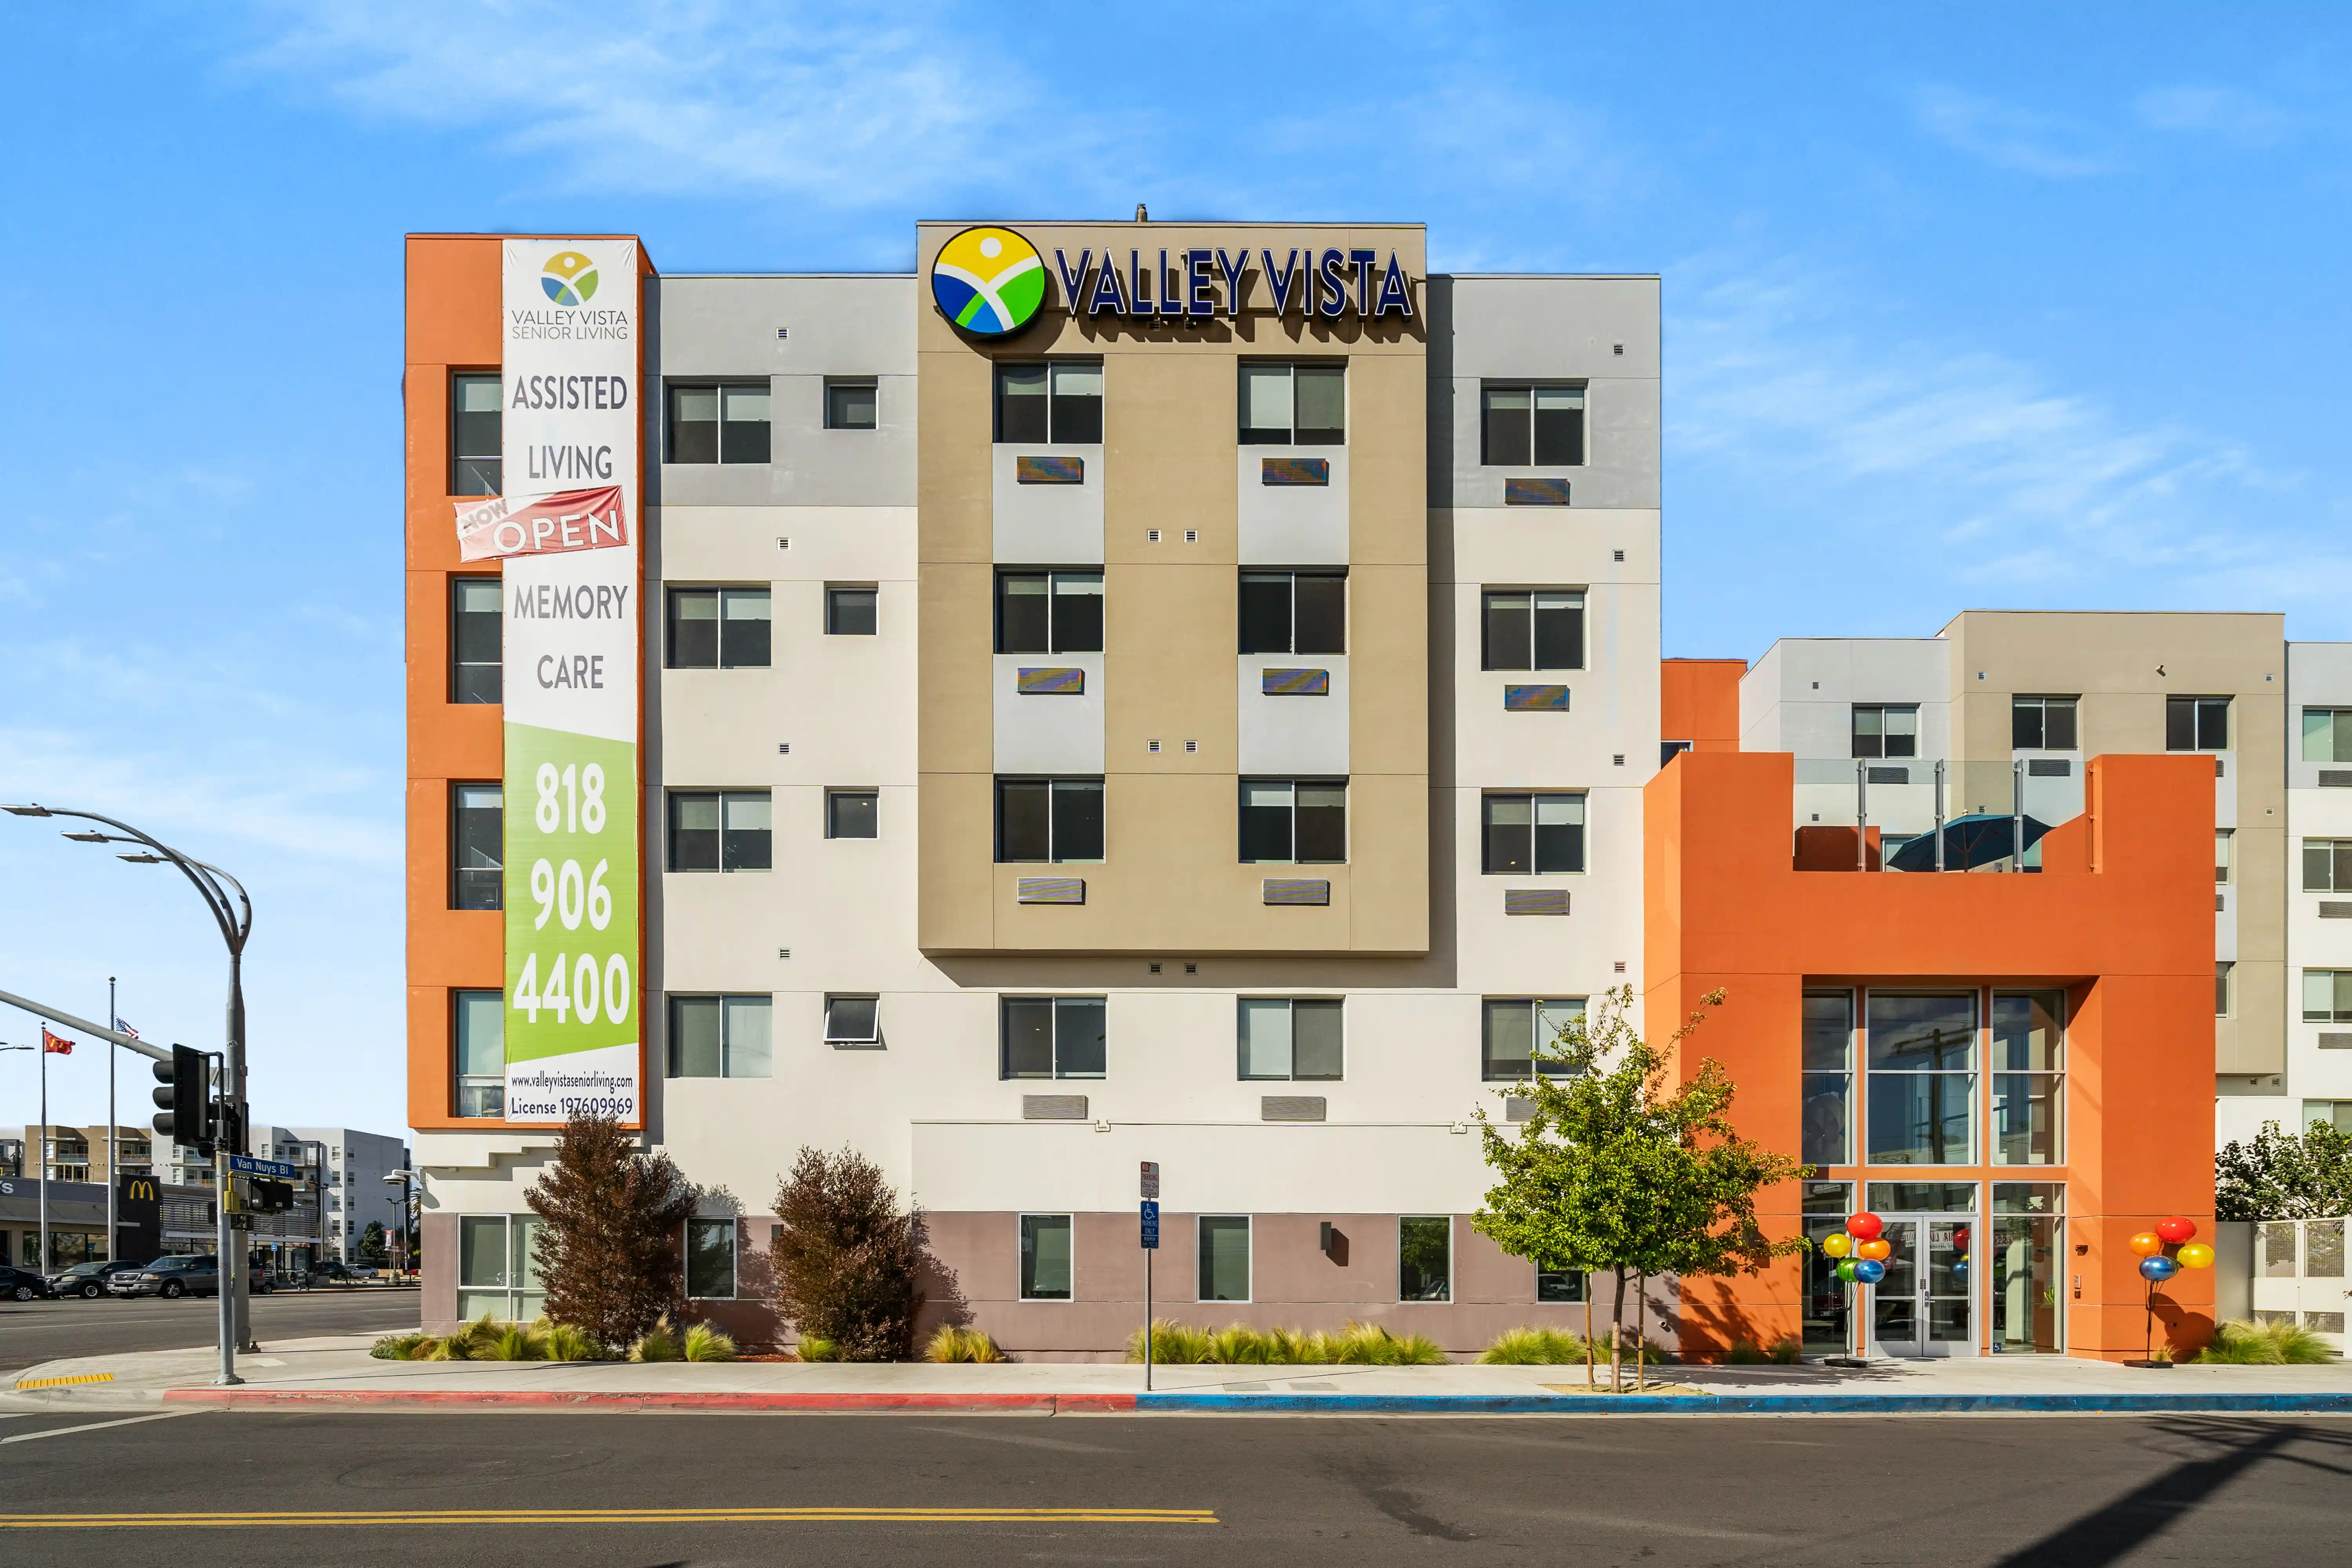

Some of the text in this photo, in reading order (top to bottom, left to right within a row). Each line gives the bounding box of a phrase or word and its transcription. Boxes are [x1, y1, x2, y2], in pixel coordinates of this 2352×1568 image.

[1054, 247, 1413, 316] VALLEY VISTA
[512, 310, 628, 325] VALLEY VISTA
[512, 327, 628, 340] SENIOR LIVING
[512, 375, 627, 410] ASSISTED
[529, 445, 612, 479] LIVING
[461, 498, 508, 534] NOW
[493, 509, 620, 554] OPEN
[514, 584, 628, 619] MEMORY
[537, 654, 604, 689] CARE
[535, 762, 606, 834] 818
[531, 858, 612, 931] 906
[513, 953, 630, 1024] 4400
[512, 1070, 633, 1094] www.valleyvistaseniorliving.com
[512, 1097, 633, 1114] License 197609969
[237, 1158, 252, 1169] Van
[256, 1161, 276, 1174] Nuys
[1142, 1173, 1158, 1181] PARKING
